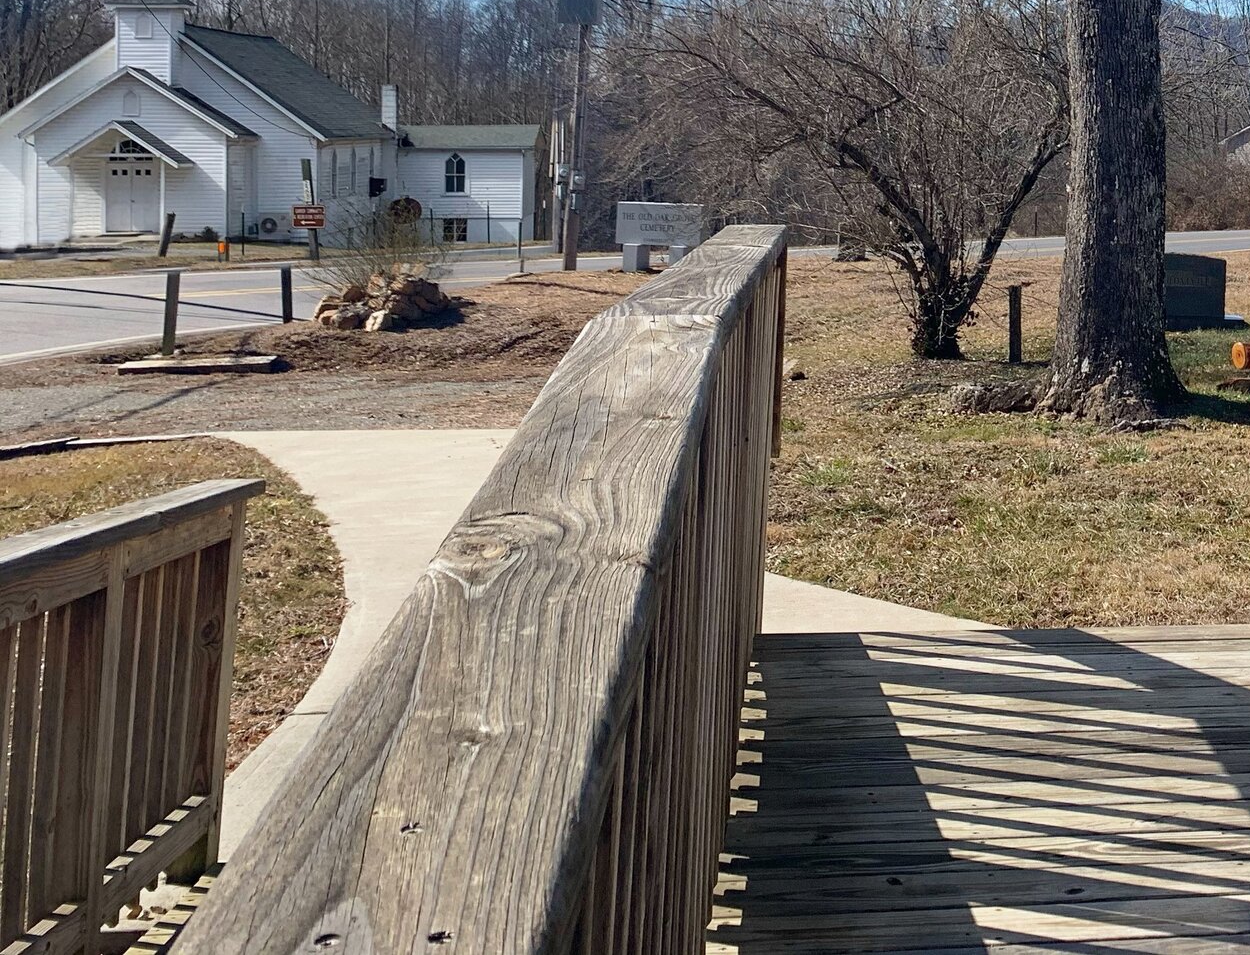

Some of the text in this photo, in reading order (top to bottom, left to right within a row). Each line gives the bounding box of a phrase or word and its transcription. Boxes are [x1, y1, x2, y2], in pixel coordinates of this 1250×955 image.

[622, 213, 635, 221] THE
[638, 213, 652, 221] OLD
[655, 214, 670, 222] OAK
[640, 224, 674, 232] CEMETERY
